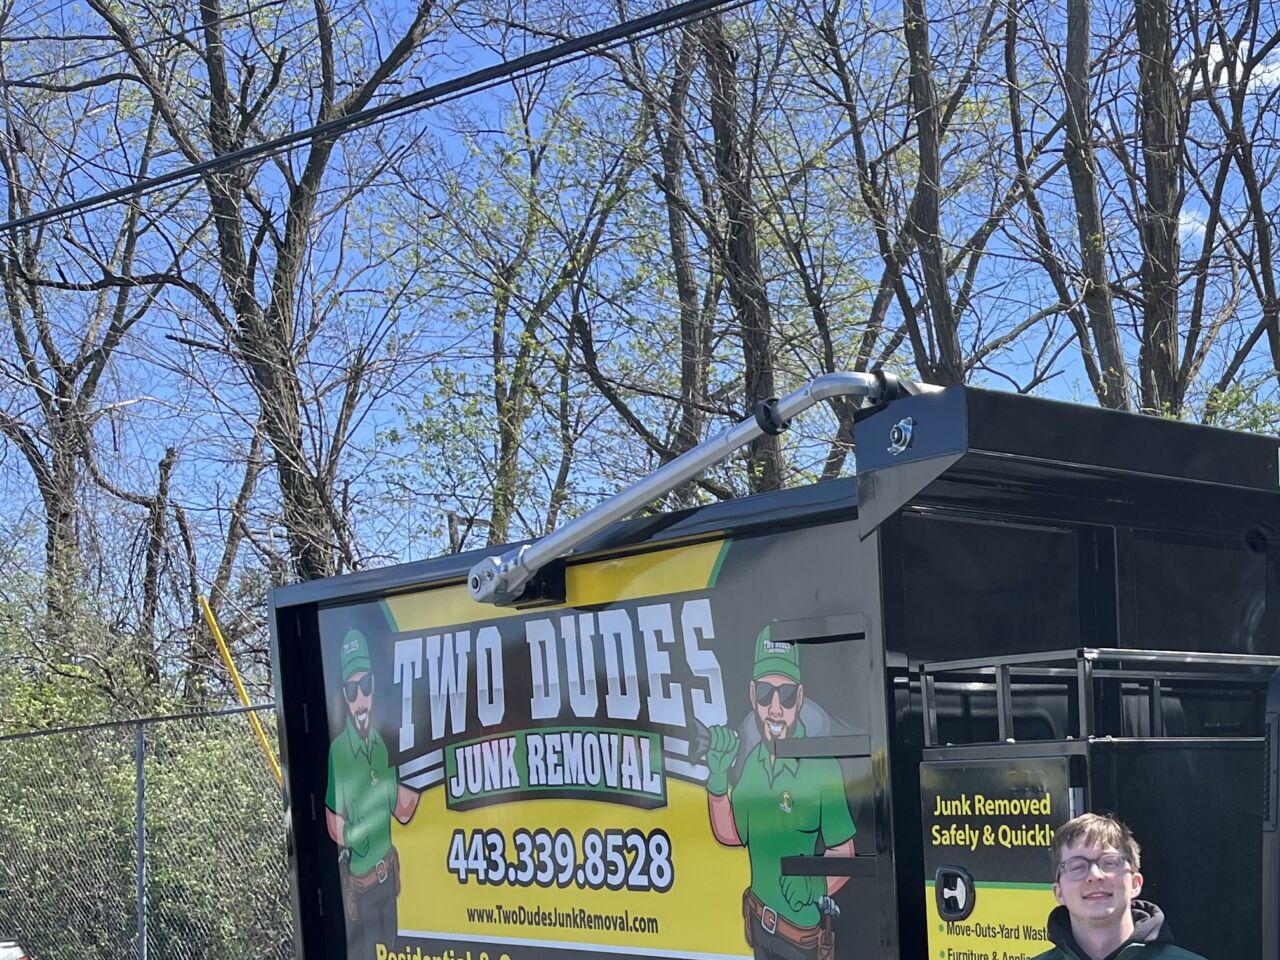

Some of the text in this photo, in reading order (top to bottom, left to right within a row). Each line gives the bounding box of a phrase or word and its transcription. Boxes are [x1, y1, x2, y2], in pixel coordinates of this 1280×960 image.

[393, 598, 728, 752] TWO DUDES
[449, 734, 661, 798] JUNK REMOVAL
[934, 793, 1051, 816] Junk Removed
[931, 824, 979, 851] Safely
[982, 825, 996, 846] &
[447, 829, 673, 891] 443.339.8528
[466, 904, 659, 934] www.TwoDudesJunkRemoval.com
[946, 921, 1020, 940] Move-Outs-Yard
